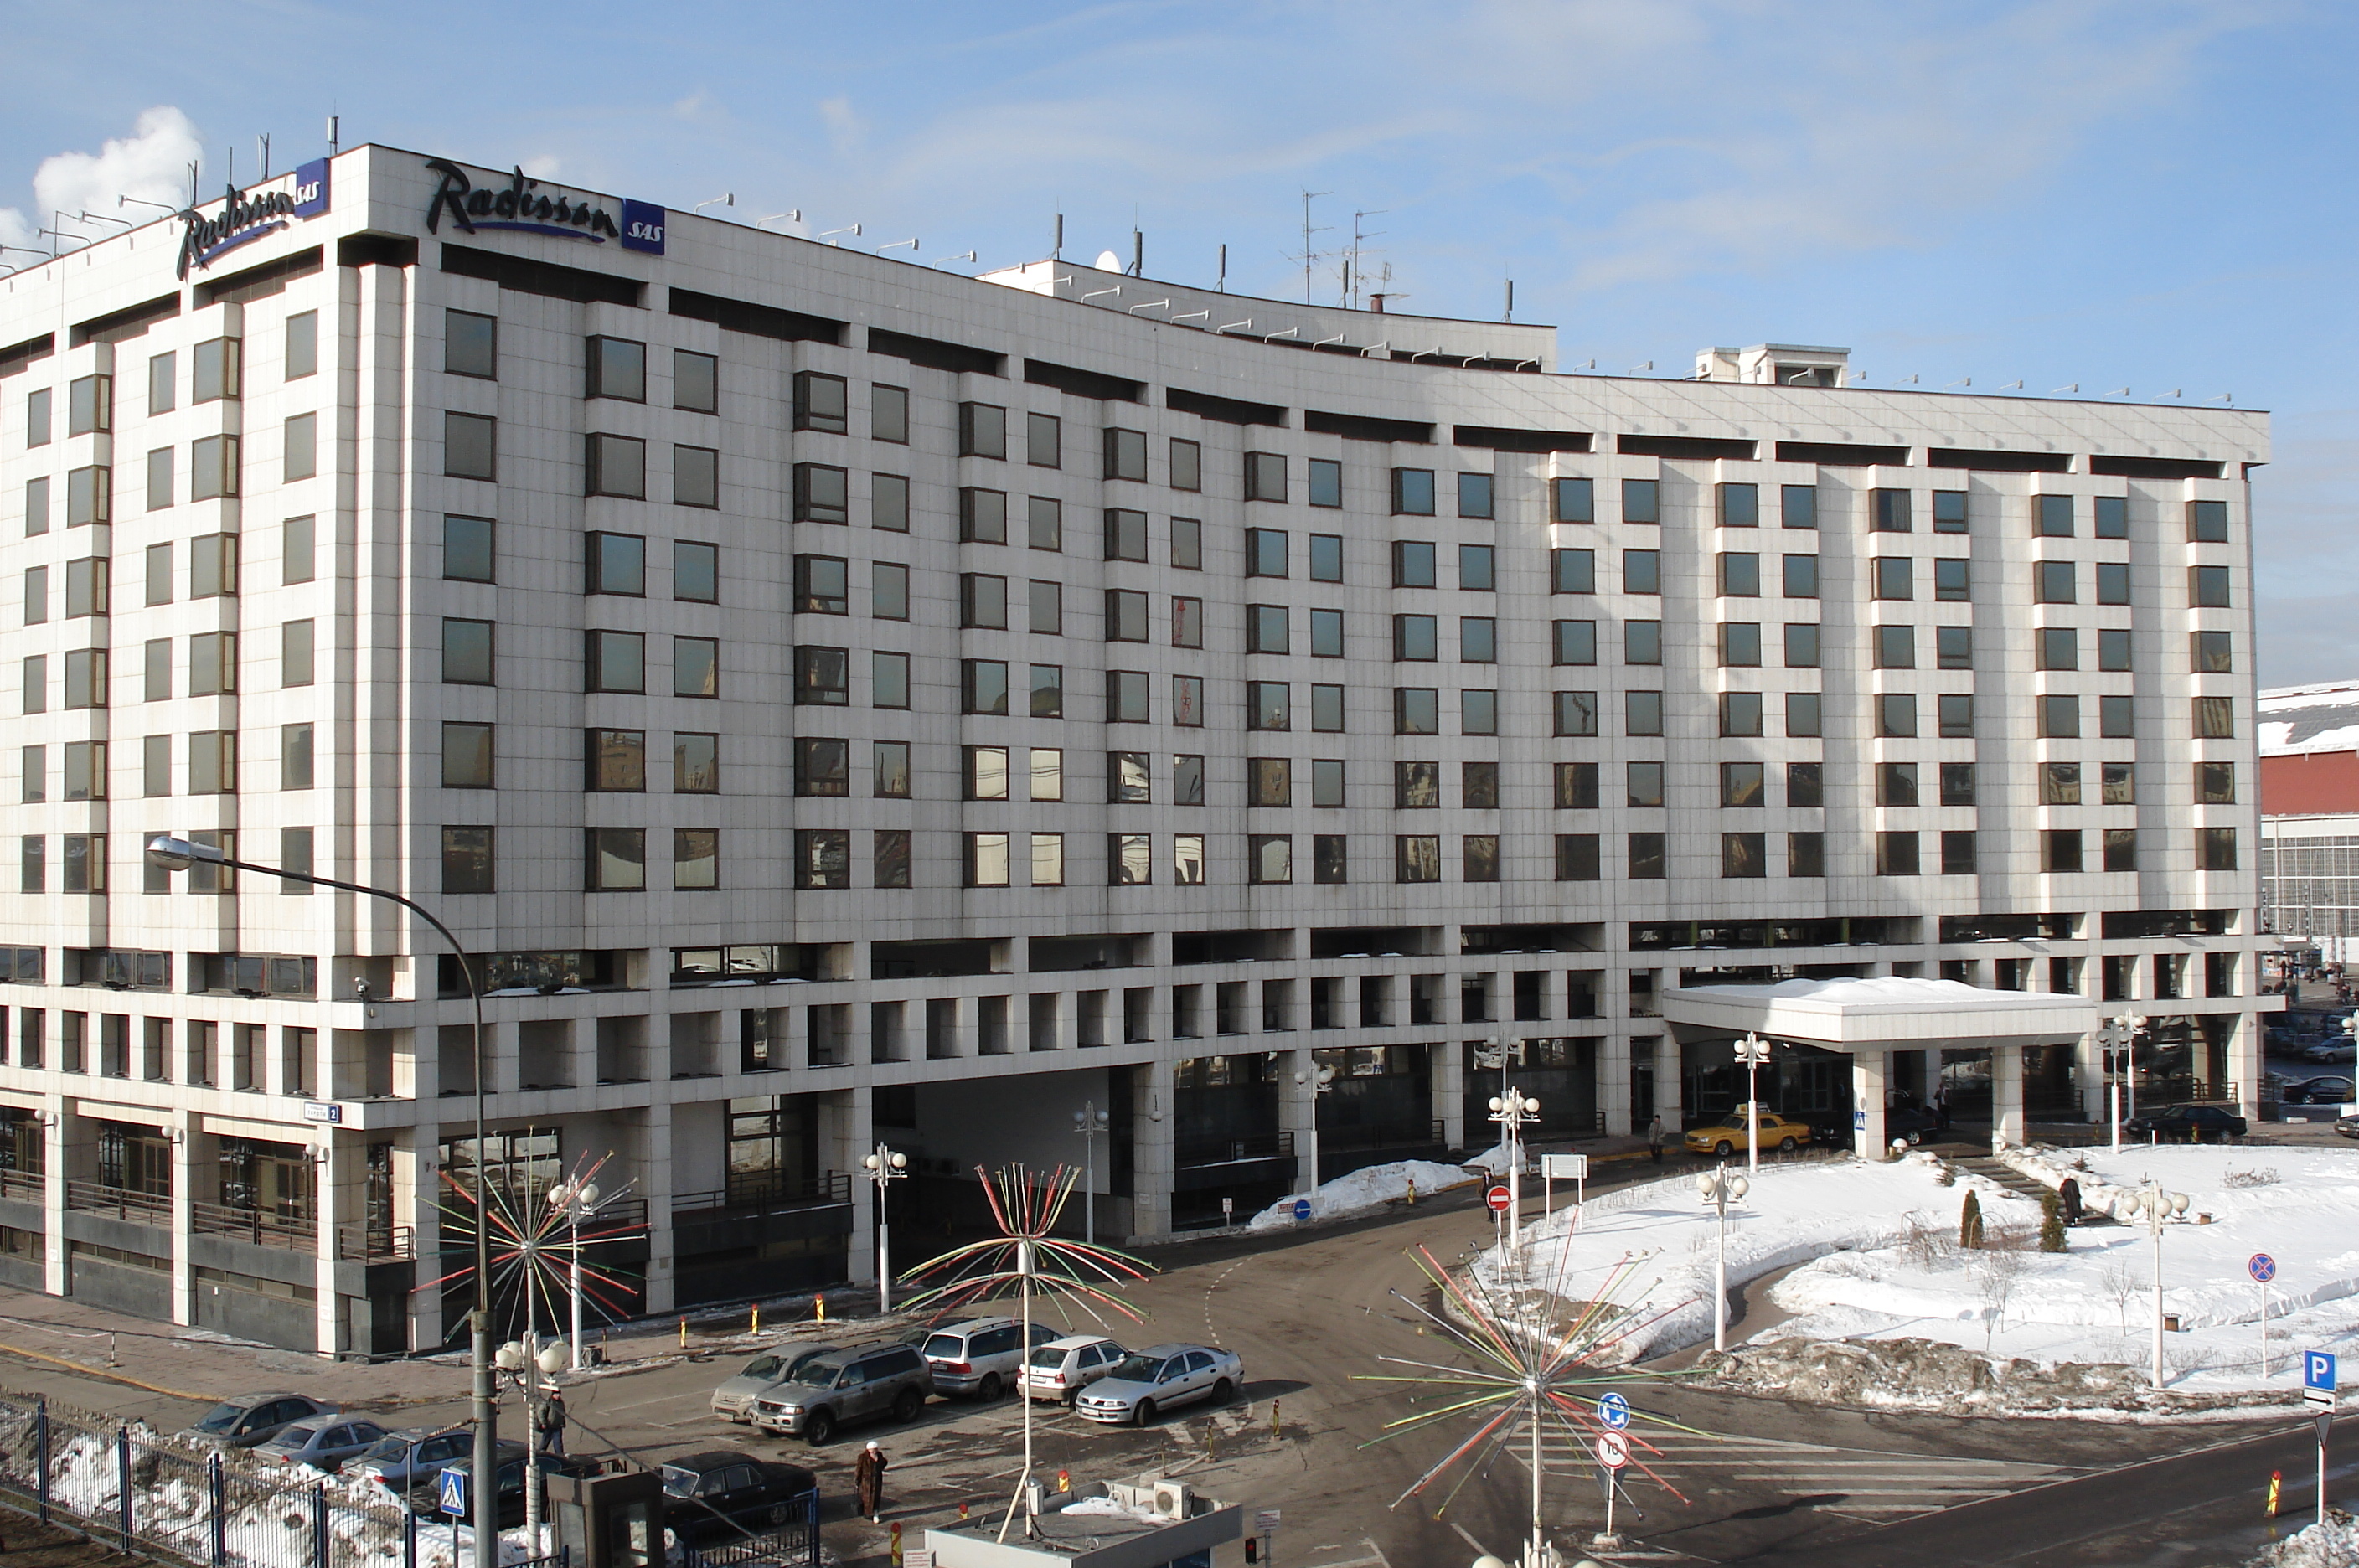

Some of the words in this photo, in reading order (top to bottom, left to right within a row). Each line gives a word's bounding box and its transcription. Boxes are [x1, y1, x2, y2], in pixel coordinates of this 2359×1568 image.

[426, 159, 619, 235] Radisson
[628, 222, 663, 242] SAS
[177, 184, 295, 281] Radisson
[295, 181, 320, 205] SAS
[330, 1109, 336, 1119] 2
[2312, 1355, 2328, 1383] P
[1606, 1442, 1619, 1455] 10
